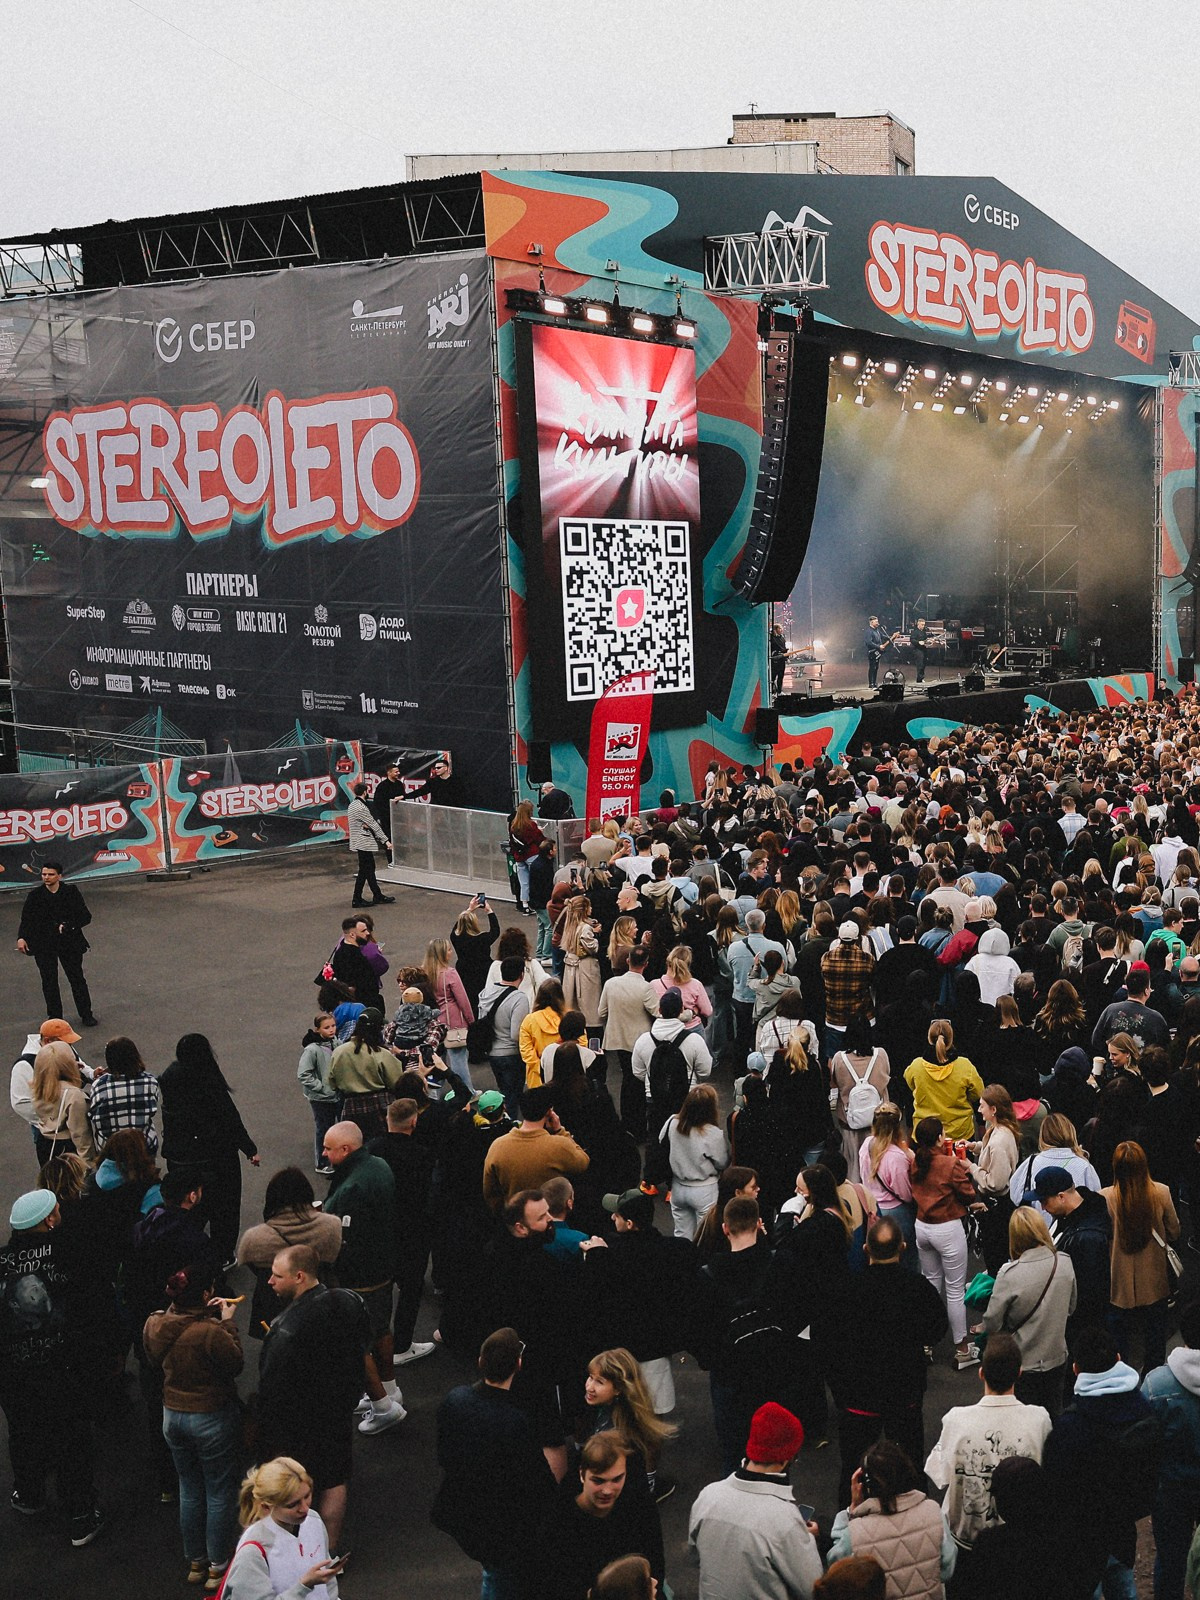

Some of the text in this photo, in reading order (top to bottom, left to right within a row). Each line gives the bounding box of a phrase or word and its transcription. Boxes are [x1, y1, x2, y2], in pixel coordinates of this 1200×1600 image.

[983, 204, 1020, 231] СБЕР
[866, 224, 1094, 351] STEREOLETO
[189, 318, 256, 353] СБЕР
[44, 392, 418, 537] STEREOLETO
[186, 572, 258, 598] ПАРТНЕРЫ
[66, 605, 106, 622] SuperStep
[127, 615, 157, 626] БАЛТИКА
[236, 610, 288, 634] BASIC CREW 21
[379, 616, 405, 629] ДОДО
[312, 638, 335, 647] РЕЗЕРВ
[379, 629, 412, 642] ПИЦЦА
[86, 646, 212, 671] ИНФОРМАЦИОННЫЕ ПАРТНЕРЫ
[603, 765, 637, 774] СЛУШАЙ
[201, 776, 337, 819] STEREOLETO
[602, 782, 622, 790] 95.0
